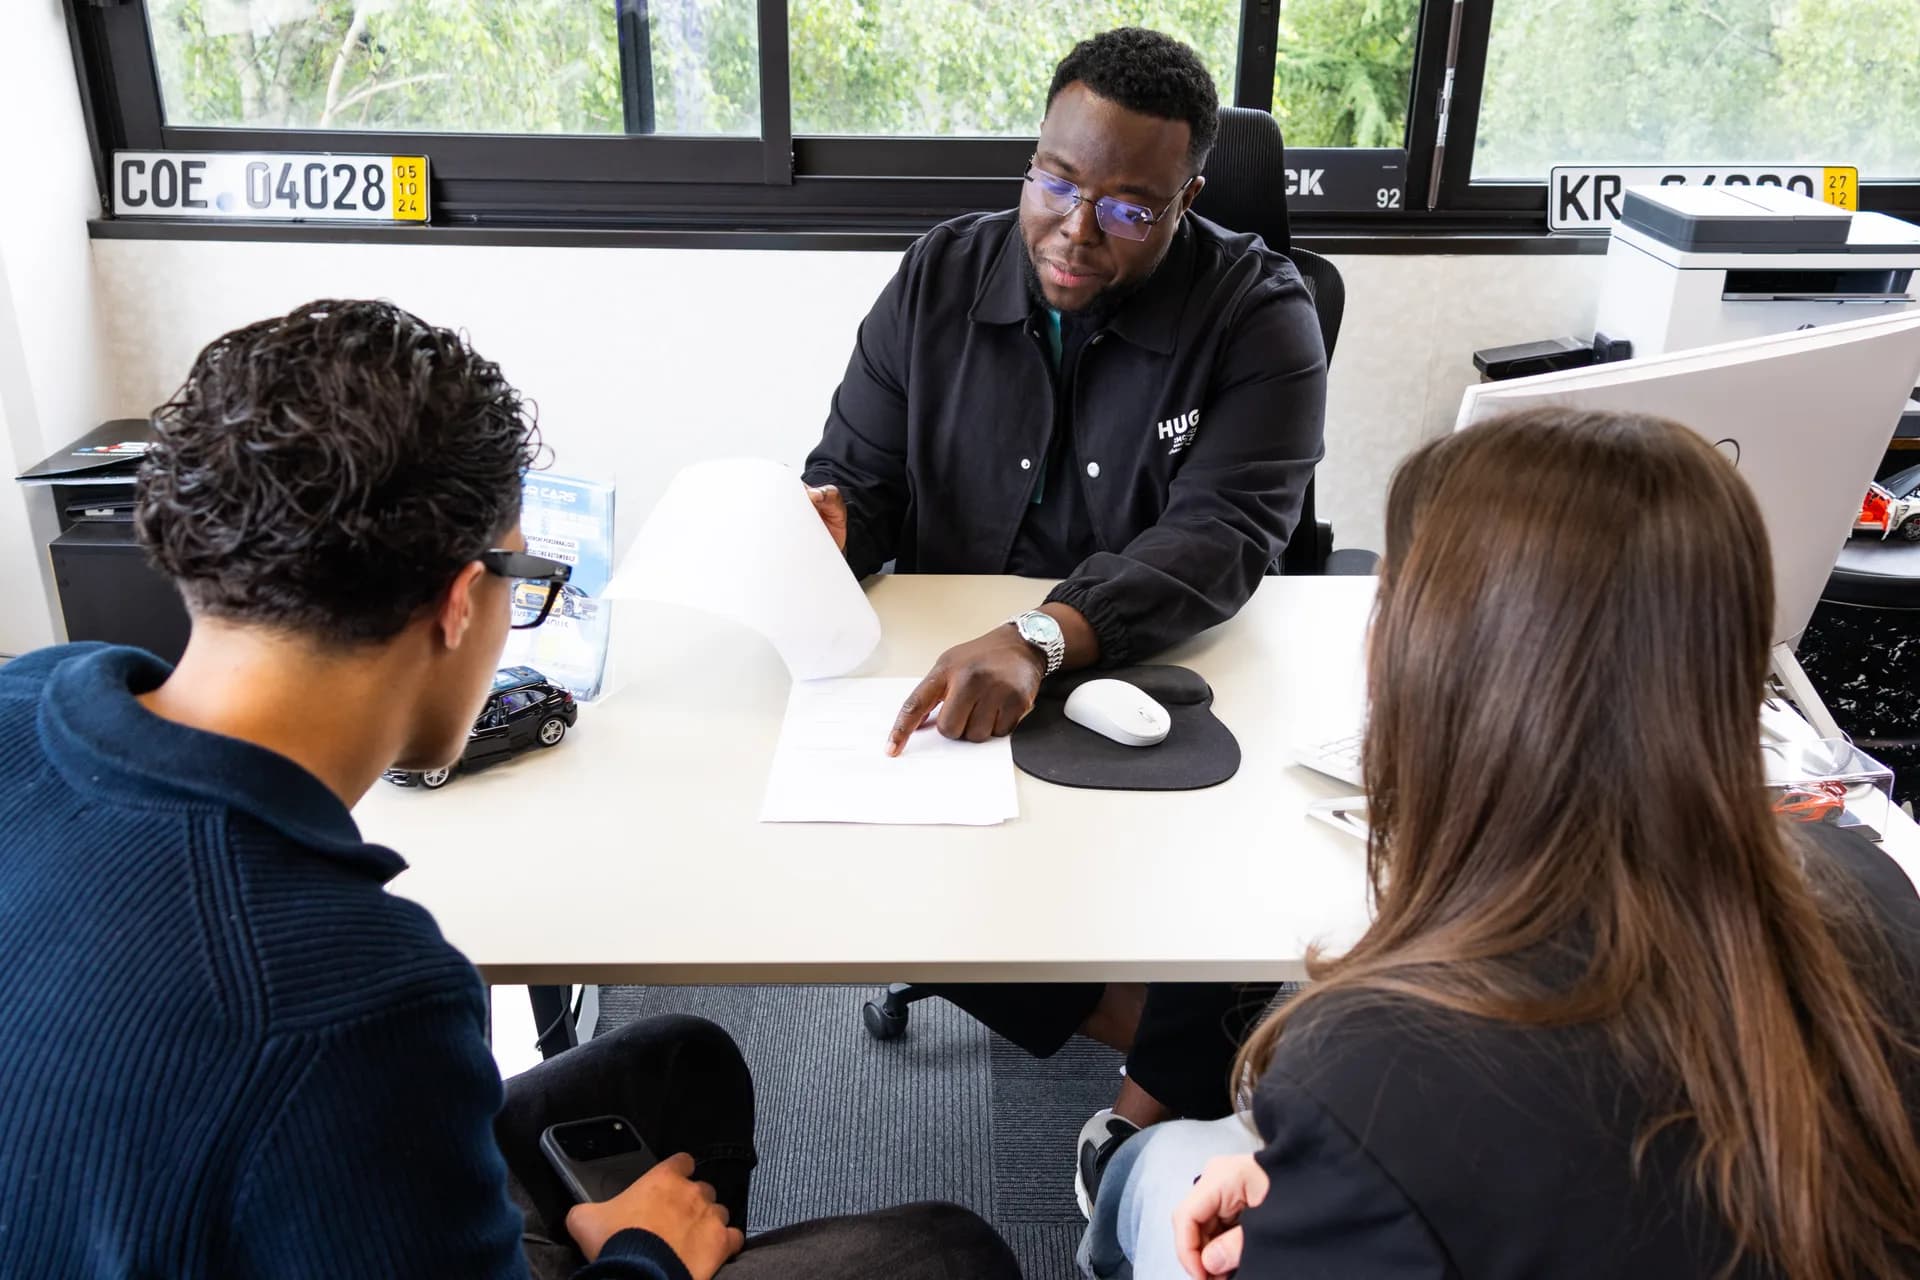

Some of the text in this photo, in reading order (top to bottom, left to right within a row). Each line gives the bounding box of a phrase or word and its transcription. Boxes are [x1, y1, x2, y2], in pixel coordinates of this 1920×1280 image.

[397, 165, 417, 179] 05
[120, 159, 386, 211] COE 04028
[399, 182, 417, 197] 10
[1829, 175, 1847, 189] 27
[1376, 188, 1401, 209] 92
[1559, 174, 1622, 222] KR
[1831, 191, 1847, 206] 12
[397, 199, 417, 213] 24
